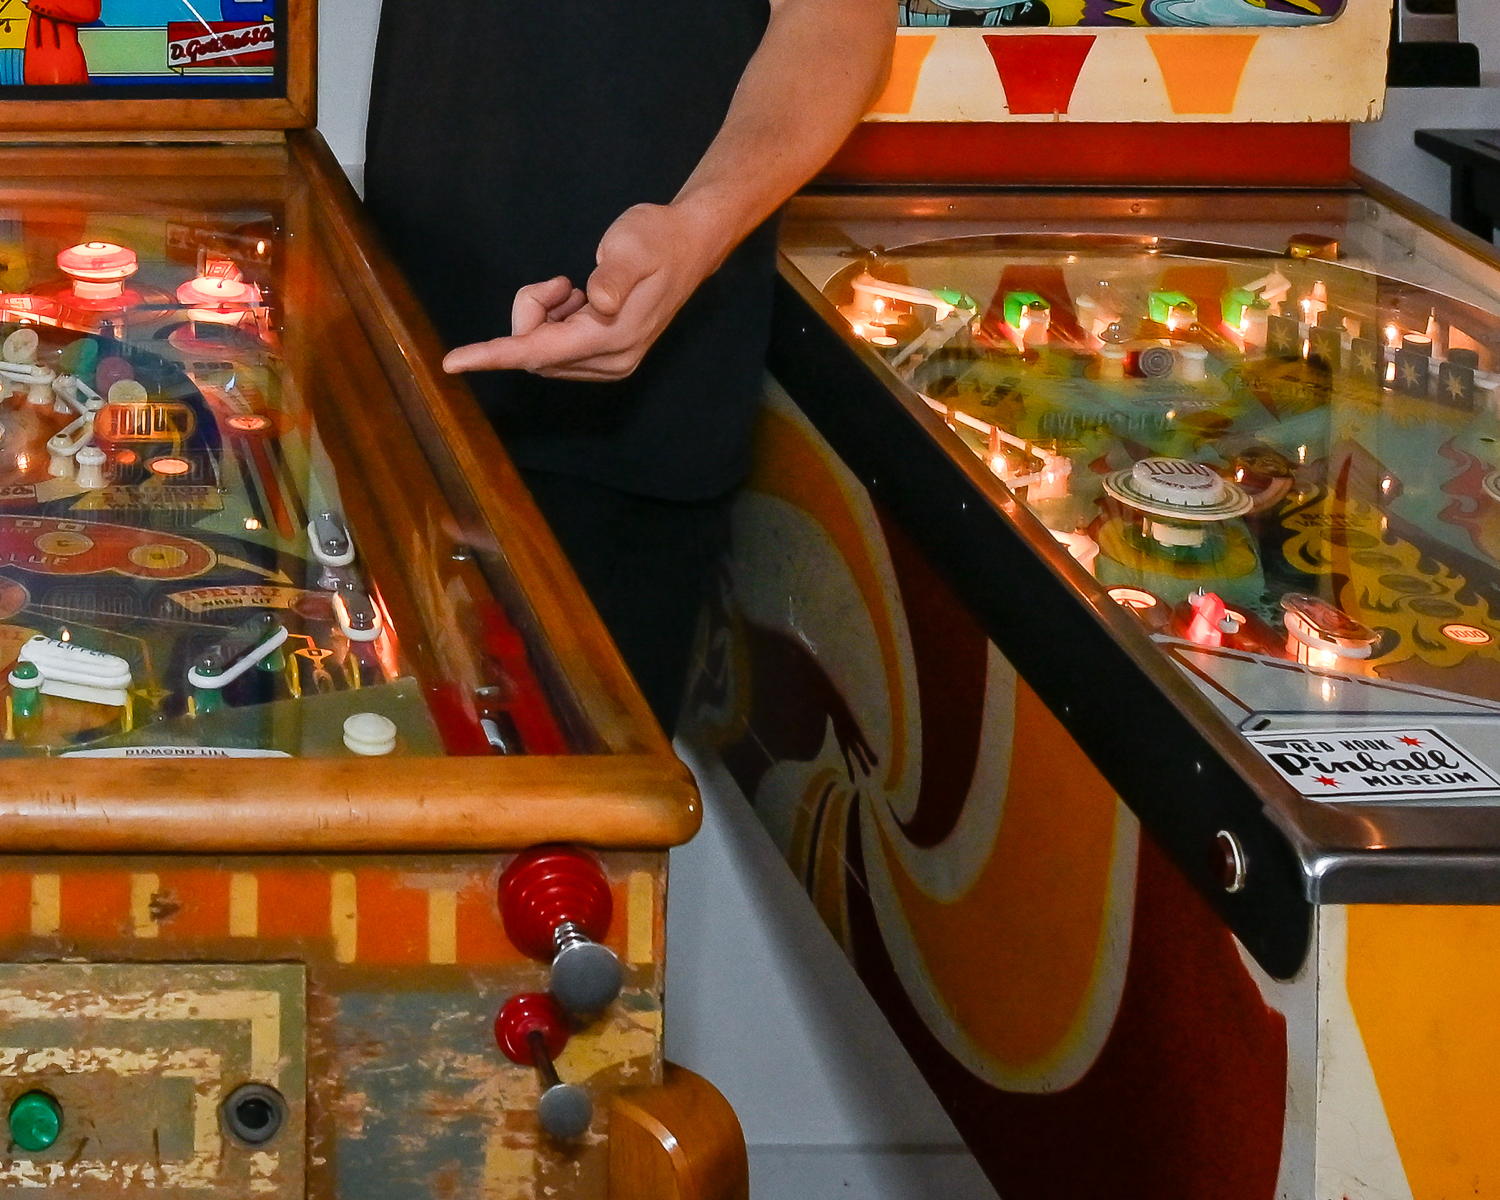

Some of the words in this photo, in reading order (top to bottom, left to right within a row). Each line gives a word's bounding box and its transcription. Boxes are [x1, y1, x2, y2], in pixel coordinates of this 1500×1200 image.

[1293, 741, 1336, 753] RED
[1338, 739, 1395, 751] HOOK
[1267, 749, 1460, 776] Pinball
[1361, 772, 1479, 787] MUSEUM
